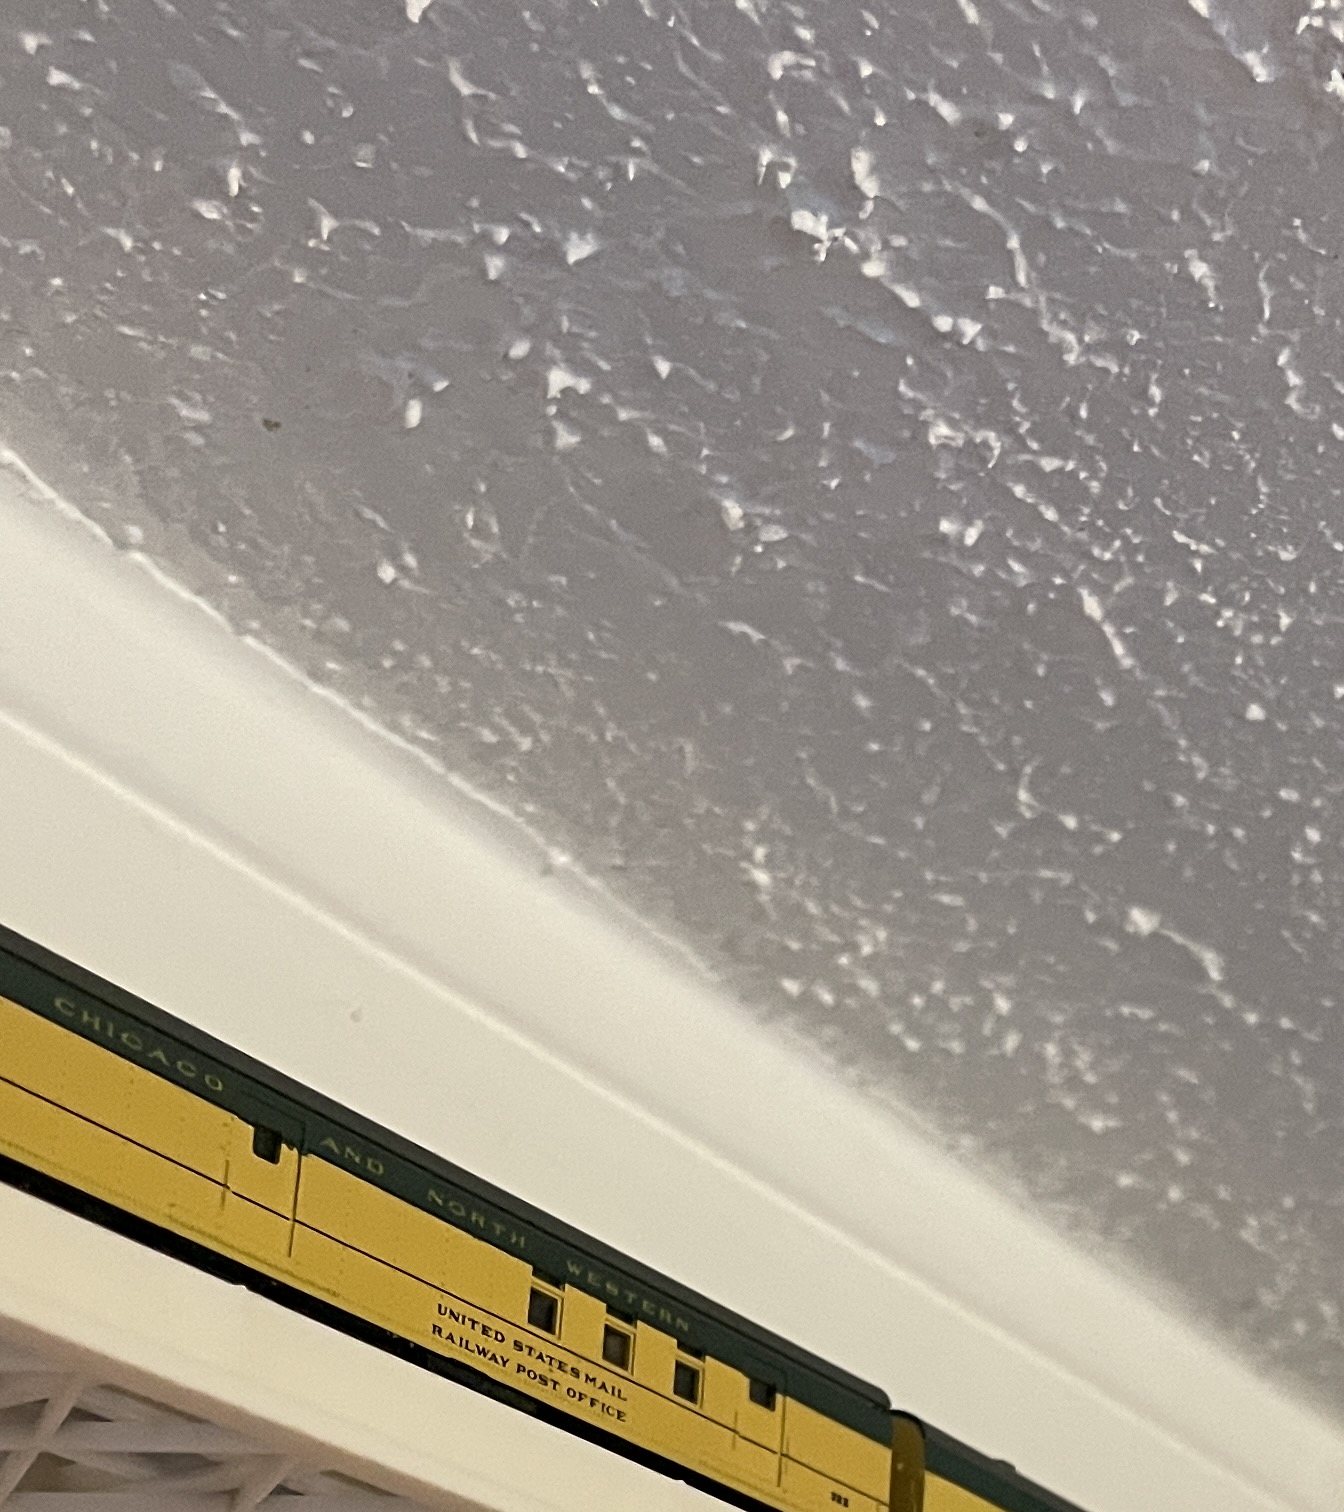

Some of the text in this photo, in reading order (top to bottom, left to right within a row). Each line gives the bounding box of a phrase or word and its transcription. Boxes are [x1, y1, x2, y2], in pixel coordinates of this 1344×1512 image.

[54, 997, 690, 1332] CHICAGO AND NORTH WESTERN
[431, 1324, 627, 1422] RAILWAY POST OFFICE
[437, 1303, 628, 1401] UNITED STATES MAIL
